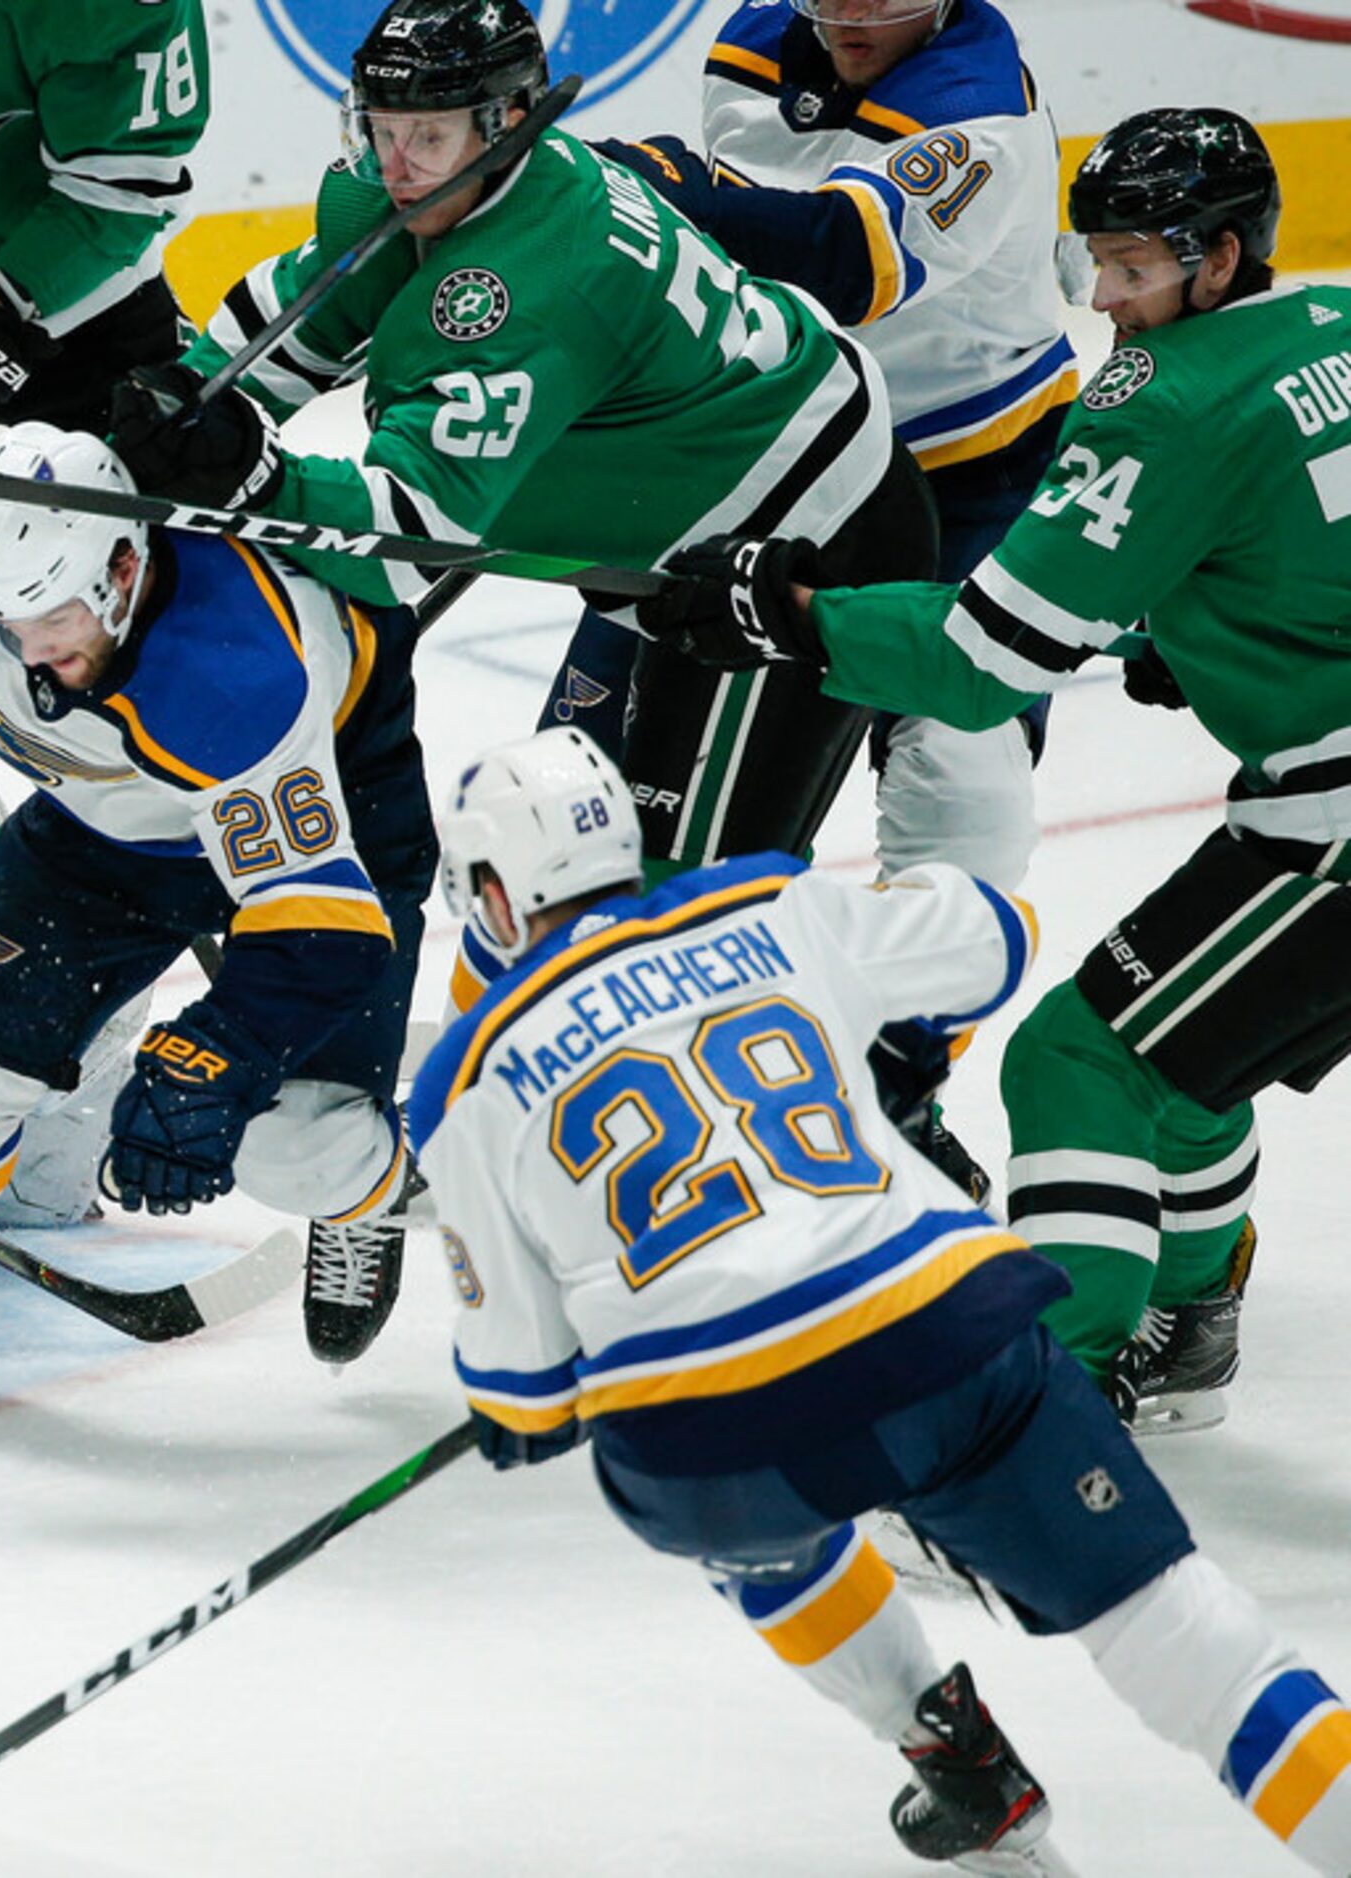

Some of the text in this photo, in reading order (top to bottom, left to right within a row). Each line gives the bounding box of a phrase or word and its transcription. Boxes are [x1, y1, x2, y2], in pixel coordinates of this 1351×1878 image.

[365, 65, 410, 78] CCM
[382, 16, 416, 37] 23
[129, 30, 197, 130] 18
[887, 129, 992, 230] 61
[431, 371, 532, 457] 23
[163, 506, 384, 557] CCM
[1028, 443, 1144, 551] 34
[212, 768, 338, 877] 26
[570, 797, 609, 834] 28
[549, 995, 891, 1290] 28
[64, 1564, 252, 1714] CCM
